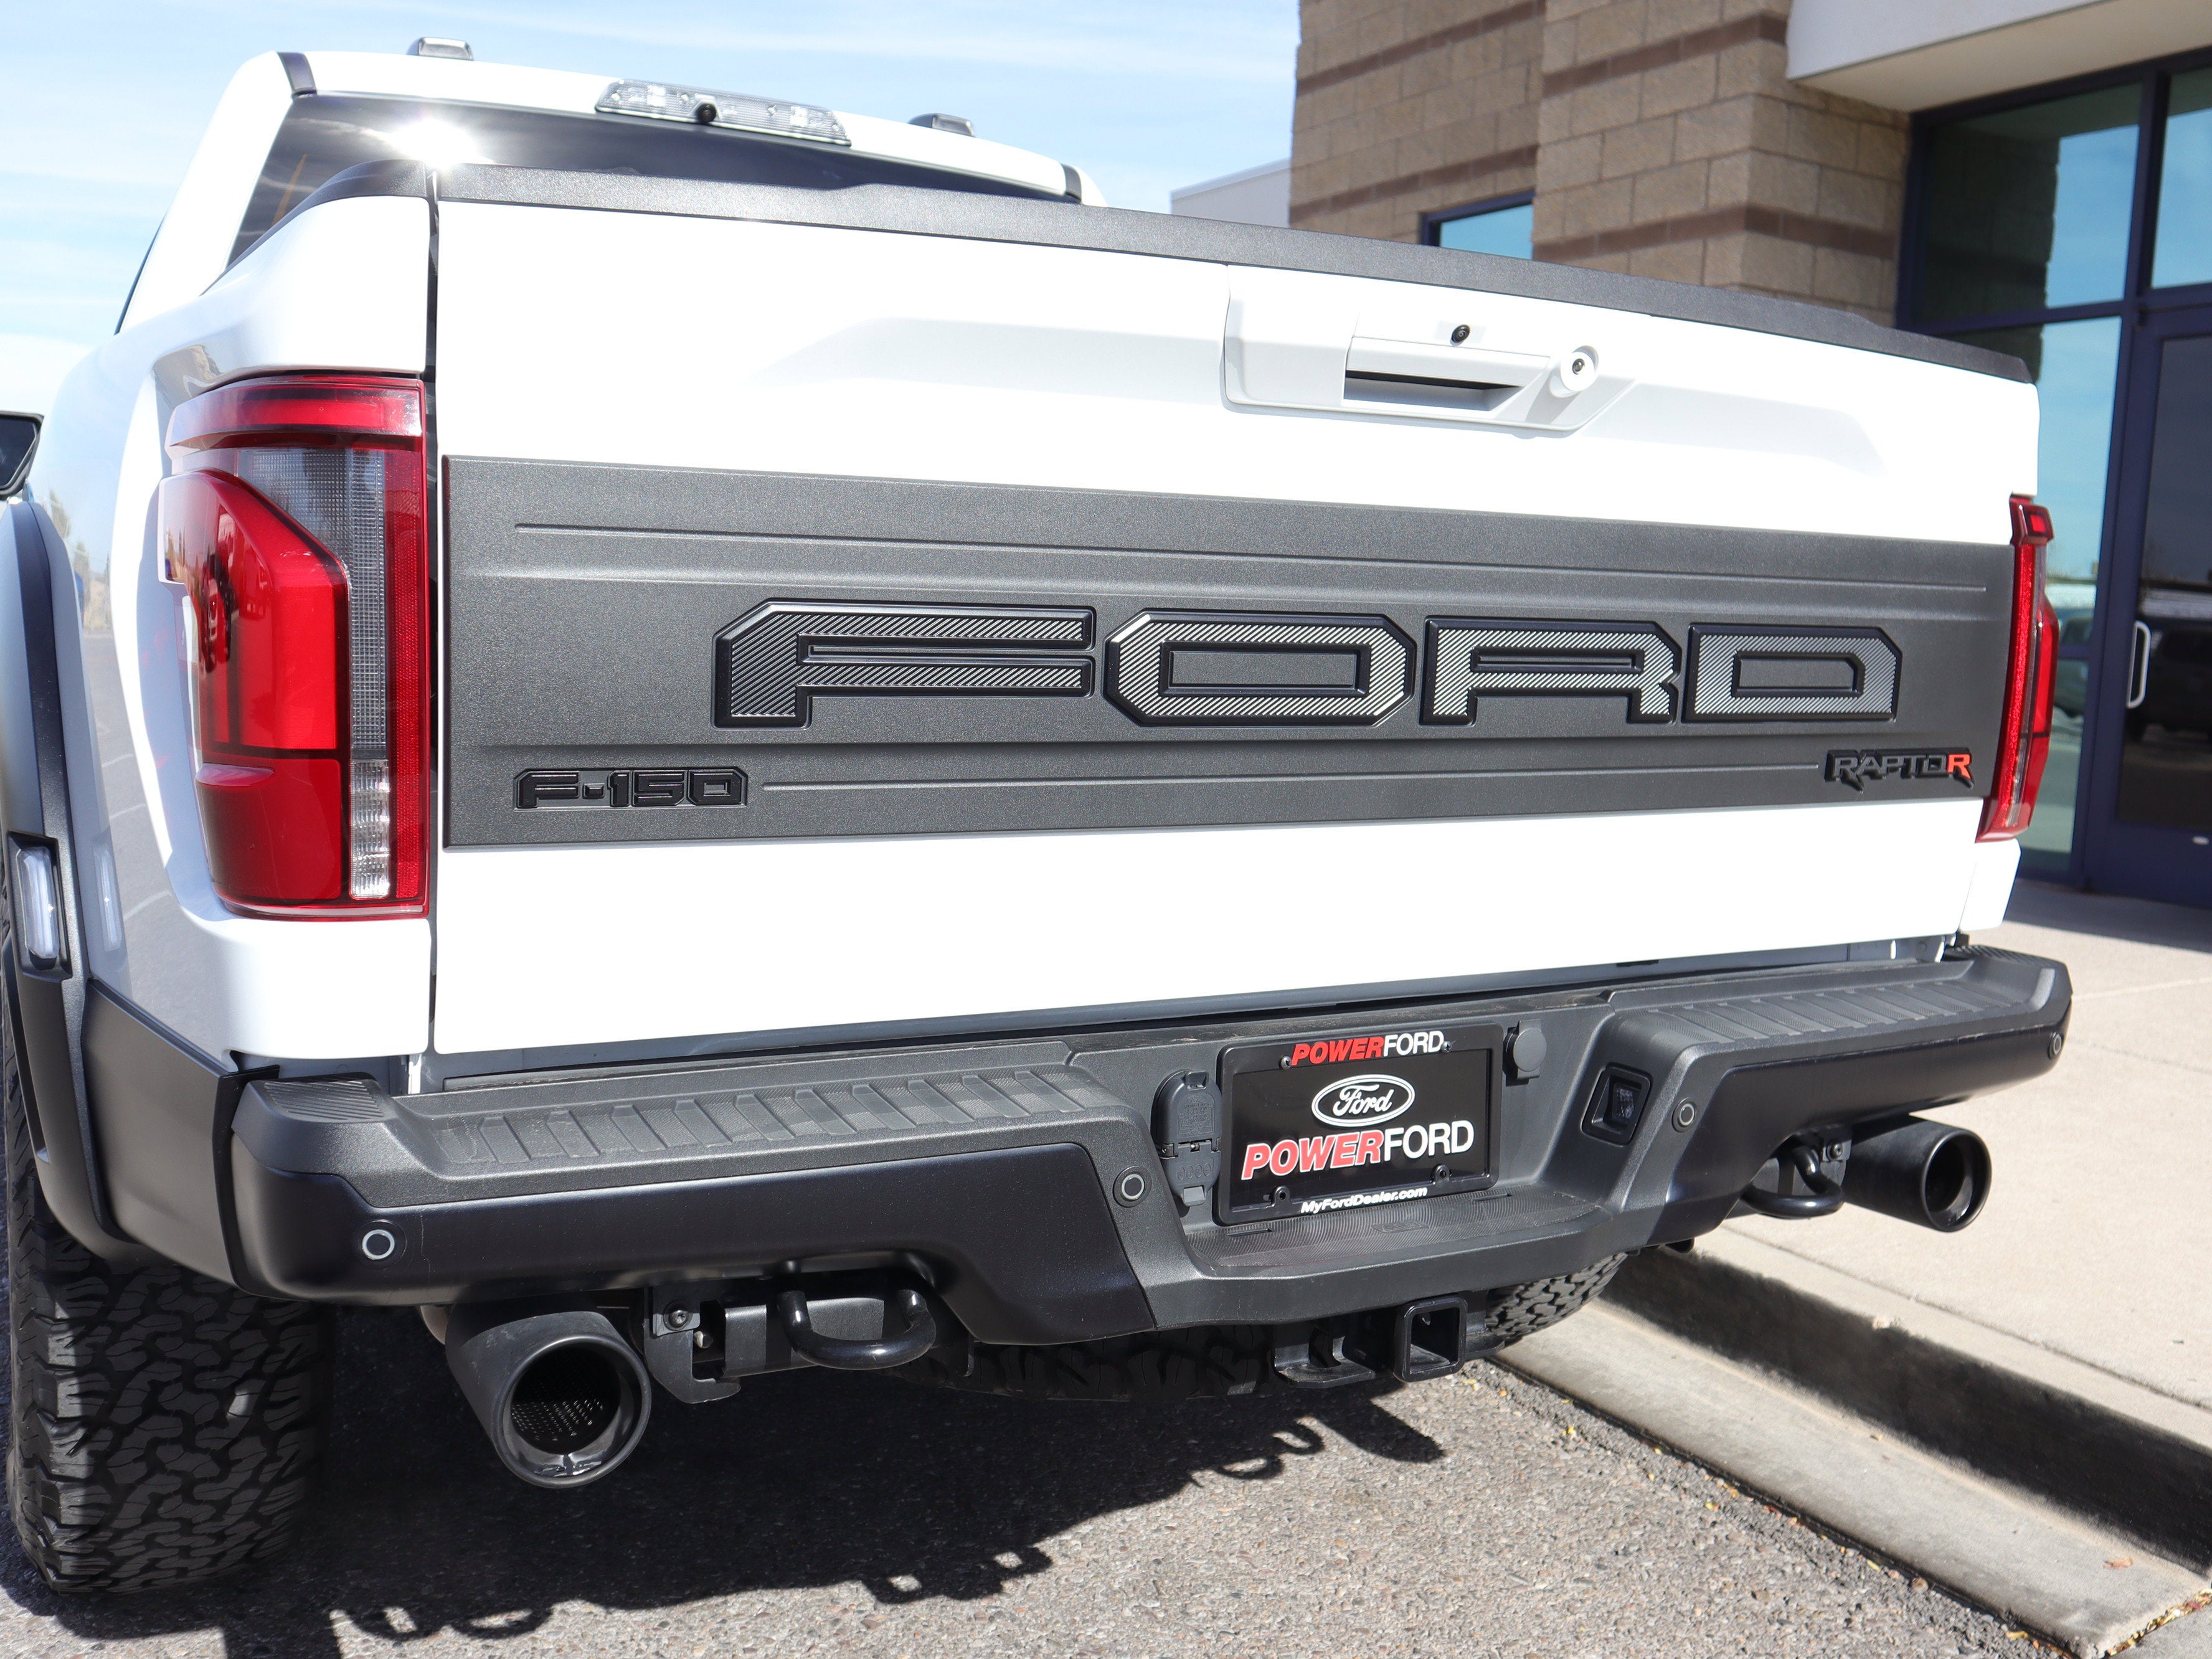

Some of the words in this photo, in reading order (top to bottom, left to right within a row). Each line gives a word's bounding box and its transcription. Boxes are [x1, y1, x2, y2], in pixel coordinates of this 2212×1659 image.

[715, 598, 1901, 727] FORD
[516, 768, 744, 808] F-150
[1825, 749, 1974, 792] RAPTOR
[1332, 1083, 1393, 1116] Ford
[1301, 1186, 1428, 1214] MyFordDealer.com
